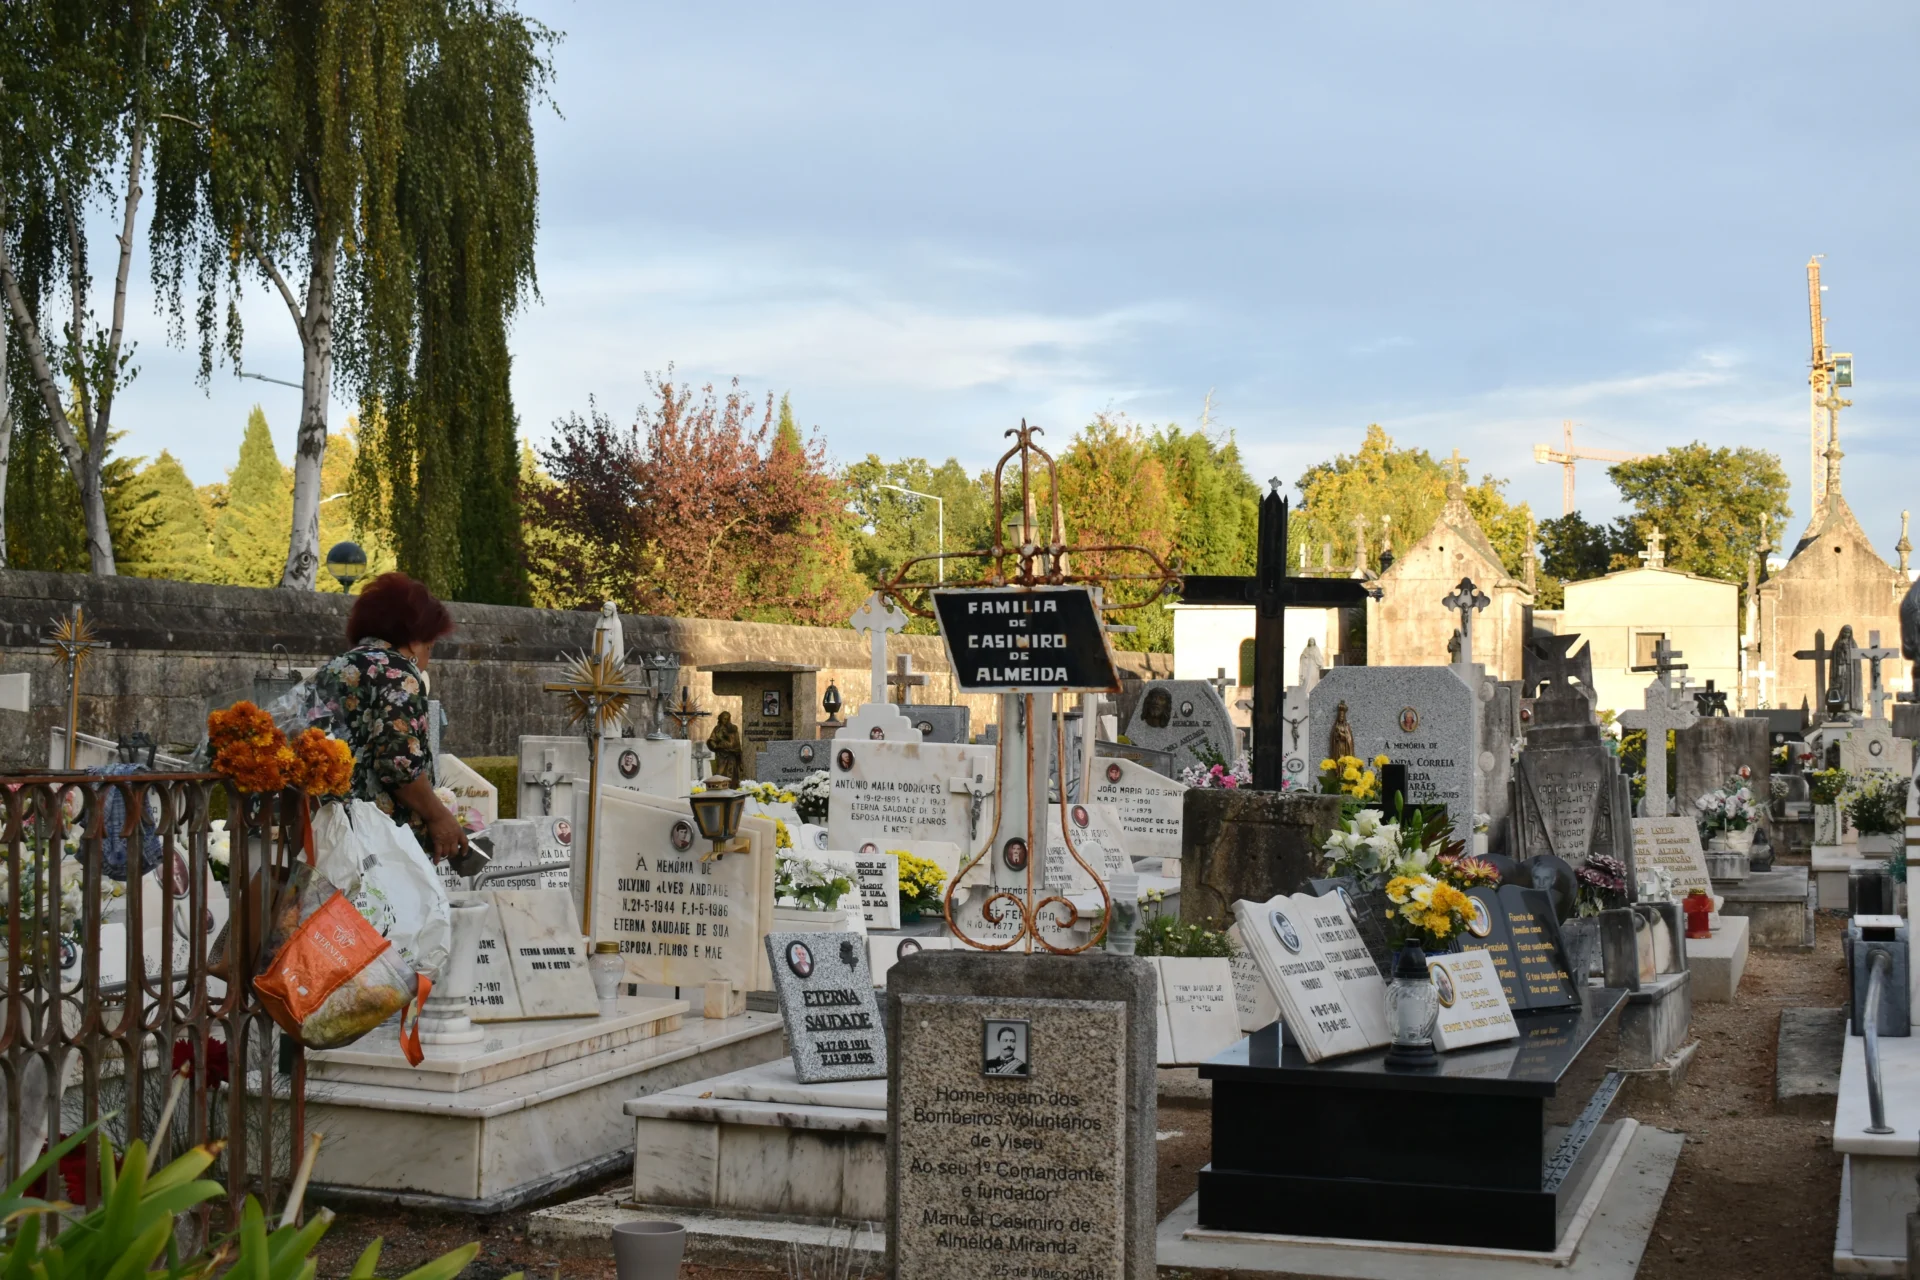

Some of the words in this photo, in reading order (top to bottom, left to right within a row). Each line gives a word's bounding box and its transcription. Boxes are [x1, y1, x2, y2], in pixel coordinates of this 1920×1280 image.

[968, 600, 1057, 614] FAMILIA
[1009, 619, 1026, 627] DE
[968, 634, 1067, 648] CASIMIRO
[1009, 652, 1029, 660] DE
[976, 667, 1068, 681] ALMEIDA
[1408, 773, 1431, 781] ERDA
[871, 781, 894, 791] MARIA
[1097, 785, 1117, 794] JOÃO
[1119, 787, 1142, 795] MARIA
[1163, 789, 1184, 797] SANT
[1408, 781, 1436, 791] ARÃES
[851, 803, 879, 812] ETERNA
[882, 804, 916, 814] SAUDADE
[851, 813, 880, 821] ESPOSA
[910, 816, 914, 824] E
[1123, 816, 1153, 824] SAUDADE
[884, 825, 887, 833] E
[1123, 825, 1147, 833] FILHOS
[1156, 827, 1178, 835] NETOS
[702, 862, 712, 875] DE
[618, 878, 650, 892] SILVINO
[657, 881, 684, 894] ALVES
[690, 882, 728, 897] ANDRADE
[622, 898, 674, 913] N.21-5-1944
[1527, 913, 1534, 921] da
[614, 918, 645, 932] ETERNA
[652, 920, 690, 935] SAUDADE
[697, 923, 707, 935] DE
[713, 924, 729, 937] SUA
[520, 948, 541, 956] ETERNA
[542, 947, 566, 955] SAUDADE
[568, 947, 576, 955] DE
[694, 945, 698, 957] E
[554, 961, 571, 969] NETOS
[802, 989, 861, 1007] ETERNA
[805, 1012, 873, 1032] SAUDADE
[936, 1087, 1044, 1107] Homenagem
[1049, 1091, 1079, 1106] dos
[914, 1107, 1001, 1126] Bombeiros
[1007, 1111, 1101, 1130] Voluntários
[970, 1134, 991, 1147] de
[997, 1134, 1043, 1149] Viseu
[910, 1159, 933, 1173] Ao
[938, 1164, 968, 1175] seu
[997, 1162, 1105, 1181] Comandante
[961, 1187, 971, 1197] e
[978, 1184, 1053, 1201] fundador
[923, 1210, 984, 1227] Manuel
[990, 1213, 1064, 1231] Casimiro
[1070, 1218, 1091, 1232] de
[936, 1233, 1003, 1250] Almeida
[1009, 1236, 1077, 1254] Miranda
[994, 1265, 1009, 1276] 25
[1013, 1266, 1027, 1277] de
[1031, 1267, 1069, 1280] Março
[1073, 1269, 1104, 1280] 2016
